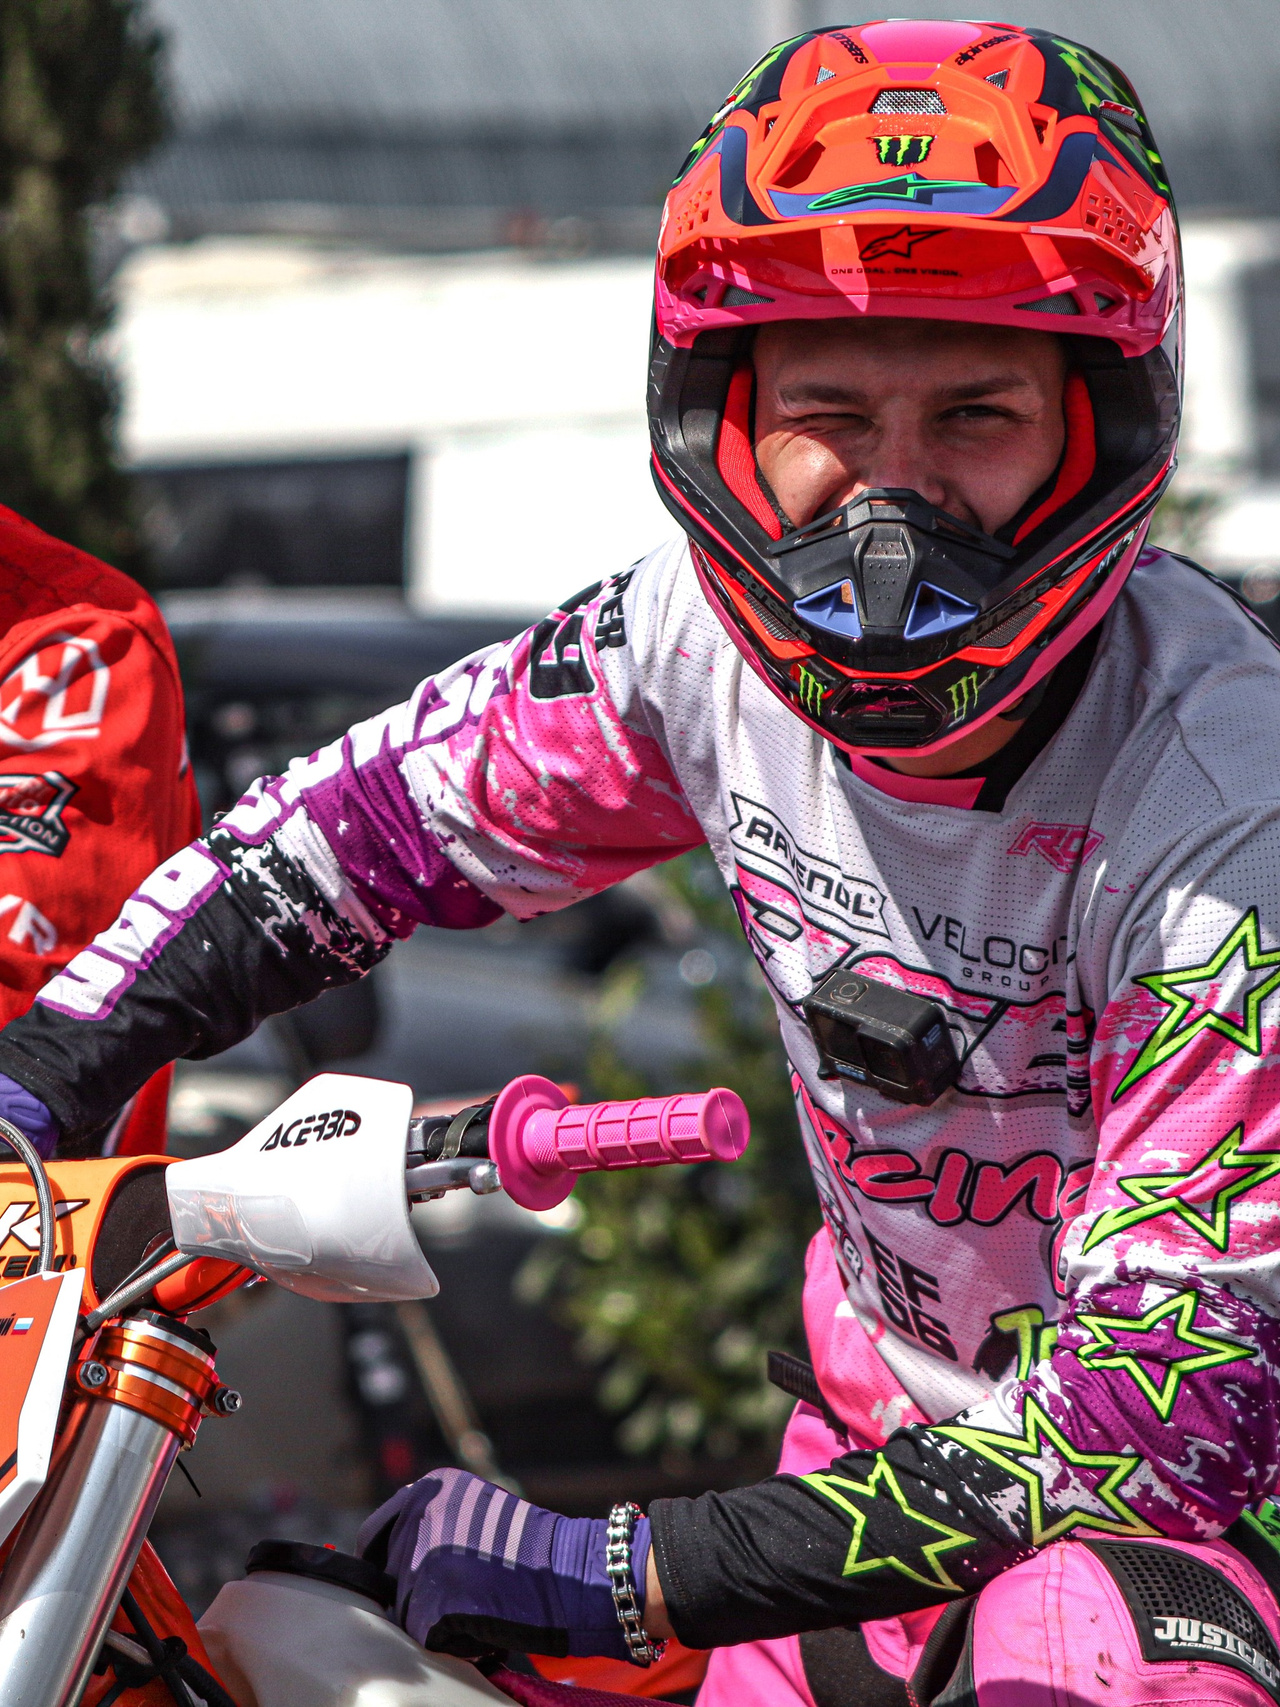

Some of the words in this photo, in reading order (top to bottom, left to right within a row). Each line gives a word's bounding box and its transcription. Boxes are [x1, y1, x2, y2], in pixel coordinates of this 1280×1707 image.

[954, 33, 1020, 66] alpinestars
[894, 267, 918, 275] ONE
[745, 816, 876, 919] RAVENOL
[963, 966, 1050, 992] GROUP
[260, 1109, 362, 1152] ACERBIS
